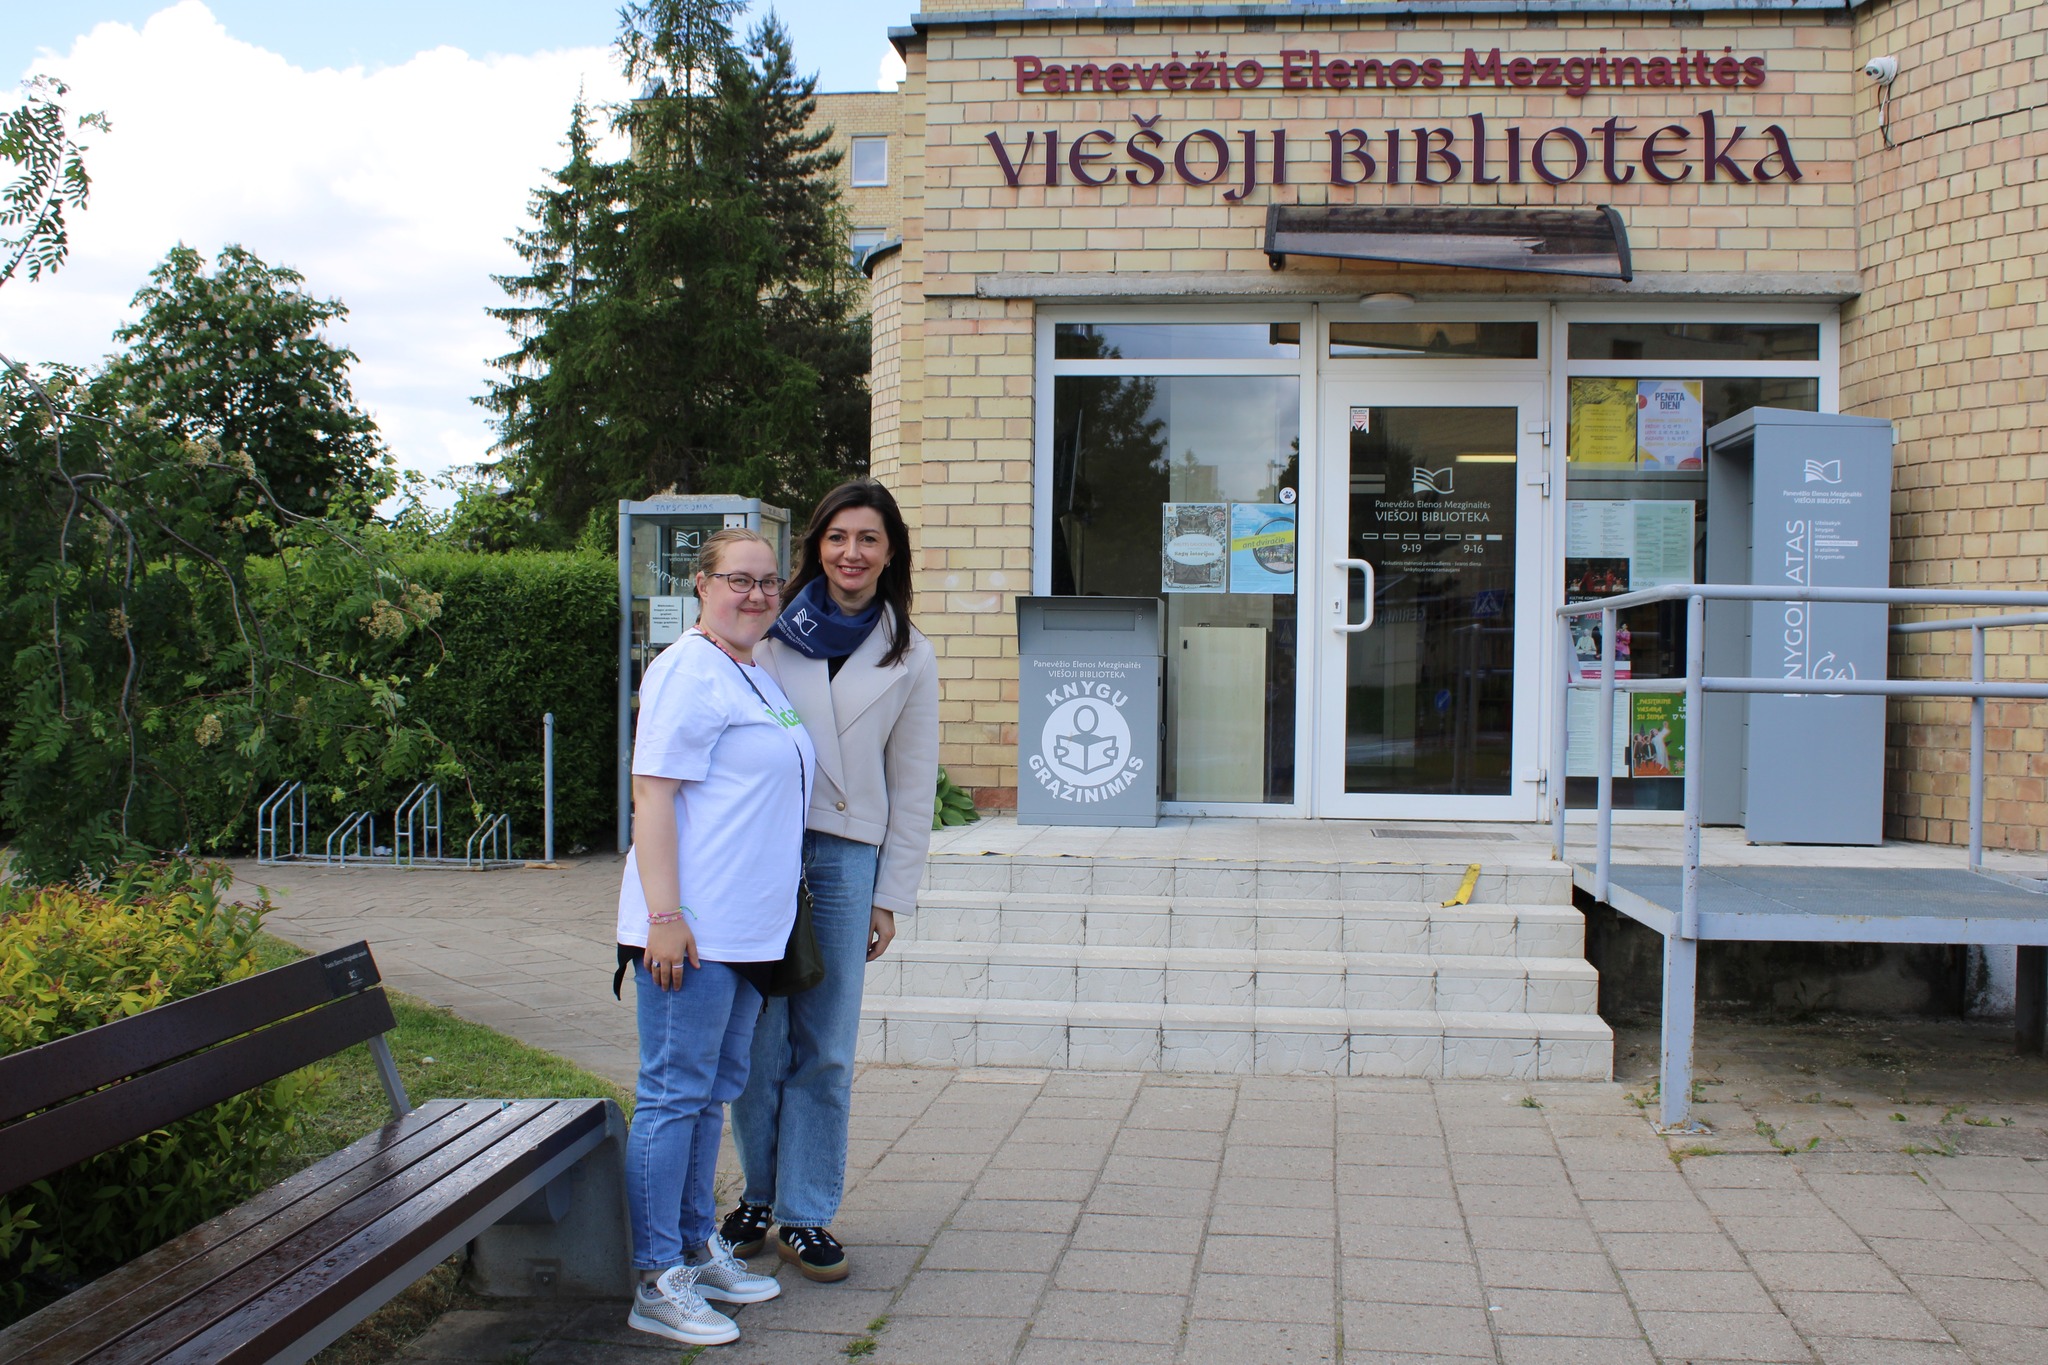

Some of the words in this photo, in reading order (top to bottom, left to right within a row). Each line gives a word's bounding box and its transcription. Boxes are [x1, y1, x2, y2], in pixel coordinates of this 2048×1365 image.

[1013, 51, 1264, 93] Panevėžio
[1280, 49, 1445, 90] Elenos
[1459, 45, 1766, 98] Mezginaitės
[984, 113, 1287, 201] VIEŠOJI
[1660, 401, 1680, 410] DIENI
[1375, 500, 1415, 509] Panevėžio
[1417, 500, 1442, 509] Elenos
[1444, 501, 1491, 510] Mezginaitės
[1375, 509, 1418, 521] VIEŠOJI
[1421, 511, 1490, 522] BIBLIOTEKA
[1242, 541, 1255, 549] ant
[1256, 537, 1286, 548] dviračio
[1401, 543, 1422, 553] 9-19
[1463, 544, 1484, 554] 9-16
[681, 578, 690, 587] IR
[1783, 519, 1805, 698] NYGOATAS
[1033, 660, 1070, 668] Panevėžio
[1072, 660, 1096, 668] Elenos
[1097, 660, 1141, 670] Mezginaitės
[1048, 669, 1077, 678] VIEŠOJI
[1079, 670, 1126, 679] BIBLIOTEKA
[1045, 680, 1129, 709] KNYGŲ
[1028, 754, 1144, 804] GRĄŽINIMAS
